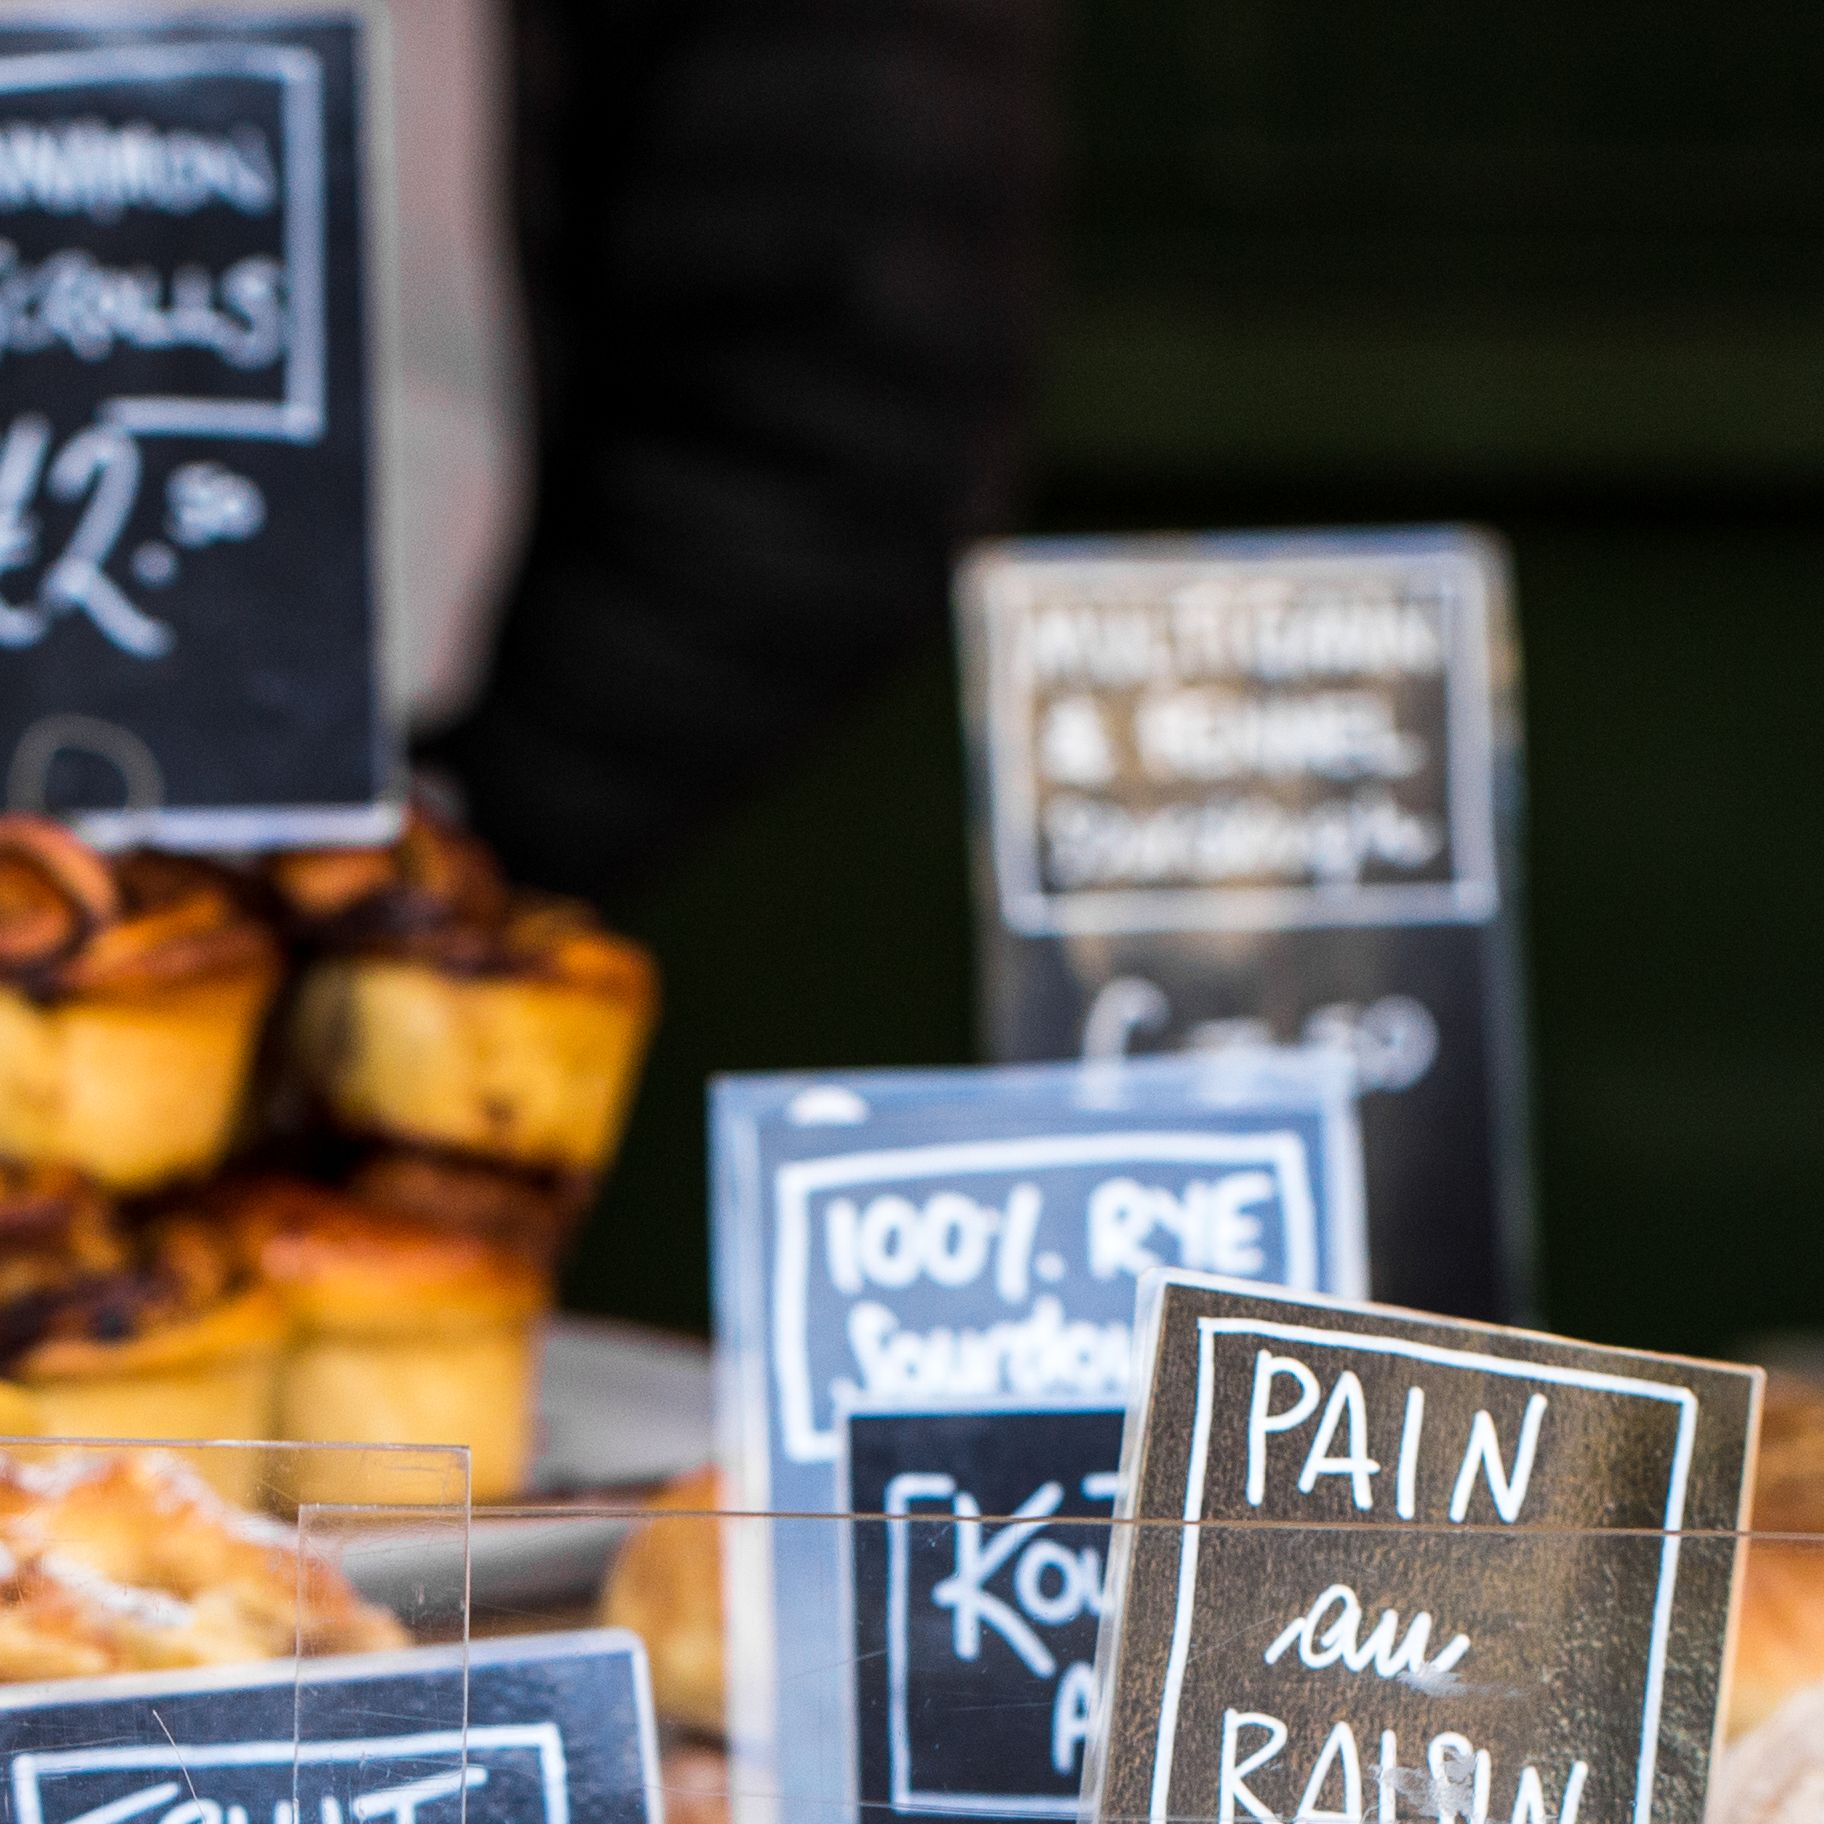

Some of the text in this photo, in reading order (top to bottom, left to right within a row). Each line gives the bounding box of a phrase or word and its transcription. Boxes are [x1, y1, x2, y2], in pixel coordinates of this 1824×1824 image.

[1087, 1170, 1274, 1282] RYE
[1245, 1347, 1547, 1523] PAIN
[1264, 1582, 1472, 1678] au
